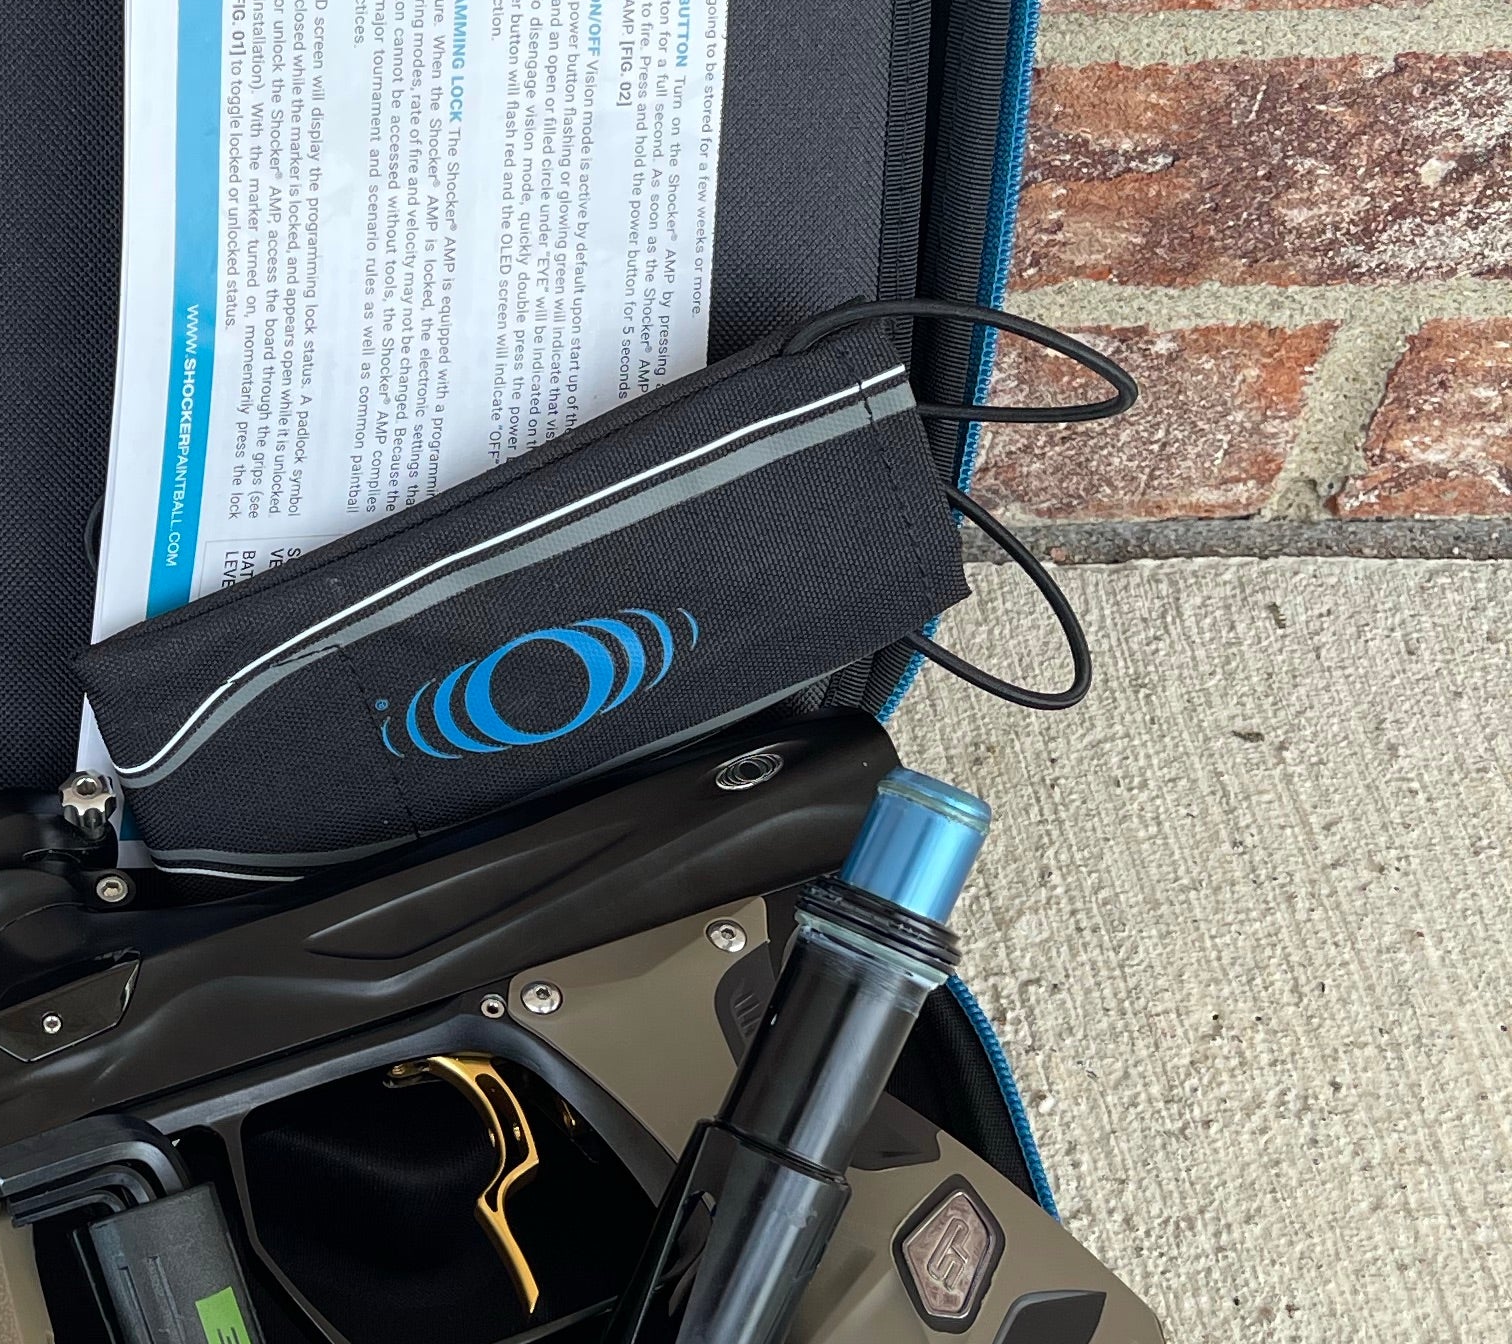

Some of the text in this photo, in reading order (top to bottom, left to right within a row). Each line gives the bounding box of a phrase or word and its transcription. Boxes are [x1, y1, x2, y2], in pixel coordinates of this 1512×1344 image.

[272, 20, 287, 73] unlock
[293, 0, 308, 50] closed
[313, 17, 324, 69] screen
[292, 54, 306, 95] while
[392, 28, 404, 83] cannot
[432, 35, 445, 79] When
[524, 17, 543, 98] disengage
[544, 55, 558, 93] open
[565, 54, 580, 102] button
[638, 56, 651, 98] Press
[227, 79, 243, 128] toggle
[370, 49, 385, 142] tournament
[450, 76, 464, 122] LOCK
[584, 60, 598, 107] Vision
[656, 74, 669, 96] full
[673, 75, 686, 109] Turn
[250, 103, 264, 137] With
[410, 95, 422, 125] rate
[506, 100, 519, 138] flash
[524, 105, 537, 150] vision
[702, 86, 714, 132] stored
[290, 127, 303, 180] marker
[307, 107, 324, 161] display
[388, 115, 401, 189] accessed
[504, 143, 516, 167] red
[543, 117, 556, 154] filled
[558, 107, 576, 166] flashing
[581, 111, 594, 154] mode
[634, 136, 648, 167] hold
[229, 133, 243, 183] locked
[408, 149, 422, 173] fire
[541, 159, 553, 200] circle
[248, 178, 262, 231] marker
[578, 174, 591, 218] active
[649, 194, 659, 230] soon
[698, 176, 710, 202] few
[227, 207, 241, 275] unlocked
[367, 185, 379, 251] scenario
[386, 196, 400, 254] without
[402, 210, 419, 268] velocity
[516, 212, 532, 265] quickly
[539, 204, 552, 247] under
[555, 191, 572, 248] glowing
[629, 200, 640, 245] power
[696, 206, 707, 253] weeks
[247, 239, 260, 287] turned
[267, 230, 278, 283] access
[303, 197, 320, 298] programming
[500, 234, 513, 275] OLED
[574, 243, 588, 294] default
[664, 249, 676, 283] AMP
[365, 258, 378, 295] rules
[400, 272, 413, 304] may
[554, 253, 566, 294] green
[625, 250, 640, 296] button
[283, 288, 296, 347] appears
[304, 304, 318, 335] lock
[402, 308, 413, 332] not
[497, 280, 508, 329] screen
[516, 272, 530, 322] double
[535, 297, 547, 321] will
[554, 298, 566, 322] will
[570, 298, 582, 333] upon
[264, 319, 278, 360] board
[362, 326, 375, 355] well
[437, 296, 452, 363] equipped
[513, 330, 525, 370] press
[654, 316, 670, 375] pressing
[237, 326, 255, 414] momentarily
[280, 351, 293, 386] open
[550, 327, 565, 384] indicate
[569, 338, 581, 371] start
[618, 339, 632, 399] seconds
[637, 359, 651, 393] AMP
[257, 366, 276, 420] through
[416, 348, 432, 417] electronic
[436, 369, 449, 399] with
[491, 364, 507, 421] indicate
[529, 348, 545, 415] indicated
[547, 387, 561, 416] that
[278, 389, 293, 425] while
[354, 386, 369, 448] common
[166, 304, 199, 566] WWW.SHOCKERPAINTBALL.COM
[235, 422, 248, 458] press
[294, 411, 310, 464] padlock
[389, 428, 407, 487] Because
[407, 424, 423, 478] settings
[250, 453, 266, 485] grips
[346, 455, 363, 513] paintball
[366, 450, 382, 512] complies
[228, 493, 244, 520] lock
[288, 470, 303, 516] symbol
[222, 551, 239, 587] LEVE
